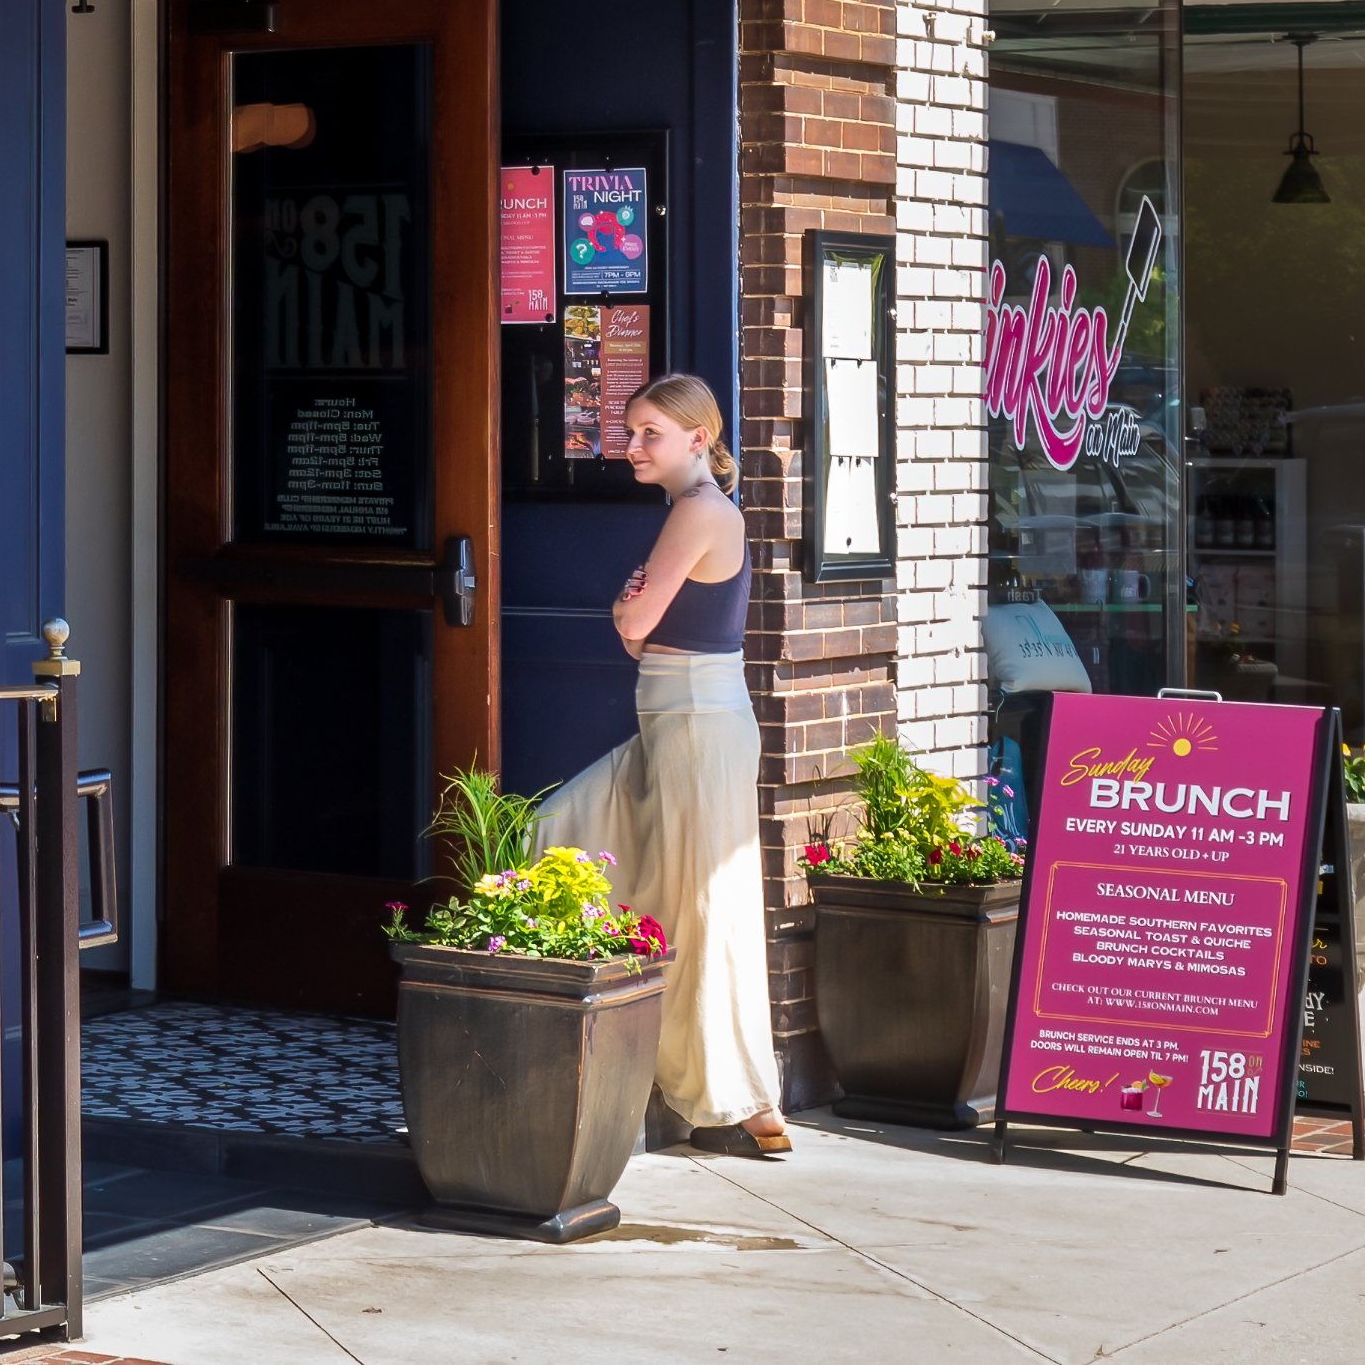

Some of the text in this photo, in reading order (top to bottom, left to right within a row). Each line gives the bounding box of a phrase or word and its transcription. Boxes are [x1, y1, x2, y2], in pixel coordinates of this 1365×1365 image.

[568, 175, 633, 191] TRIVIA
[501, 198, 548, 210] UNCH
[593, 190, 642, 203] NIGHT
[981, 253, 1111, 472] inkies
[1060, 747, 1156, 787] Sunday
[1089, 778, 1292, 821] BRUNCH
[1065, 817, 1117, 833] EVERY
[1120, 822, 1187, 840] SUNDAY
[1191, 826, 1204, 841] 11
[1208, 828, 1235, 842] AM
[1259, 832, 1284, 847] PM
[1113, 844, 1125, 854] 21
[1128, 845, 1170, 858] YEARS
[1171, 847, 1201, 860] OLD
[1211, 850, 1230, 862] UP
[1096, 882, 1235, 906] SEASONAL MENU
[1056, 910, 1273, 938] HOMEMADE SOUTHERN FAVORITES
[1073, 925, 1252, 950] SEASONAL TOAST & QUICHE
[1096, 941, 1225, 961] BRUNCH COCKTAILS
[1072, 952, 1246, 977] BLOODY MARYS & MIMOSAS
[1052, 982, 1258, 1009] CHECK OUT OUR CURRENT BRUNCH MENU
[1030, 1040, 1189, 1063] DOORS WILL REMAIN OPEN TIL 7 PM!
[1039, 1029, 1075, 1041] BRUNCH
[1077, 1033, 1114, 1044] SERVICE
[1116, 1036, 1140, 1047] ENDS
[1142, 1038, 1155, 1048] AT
[1156, 1039, 1162, 1049] 3
[1031, 1065, 1120, 1094] Cheers!
[1199, 1050, 1247, 1085] 158
[1197, 1076, 1260, 1114] MAIN
